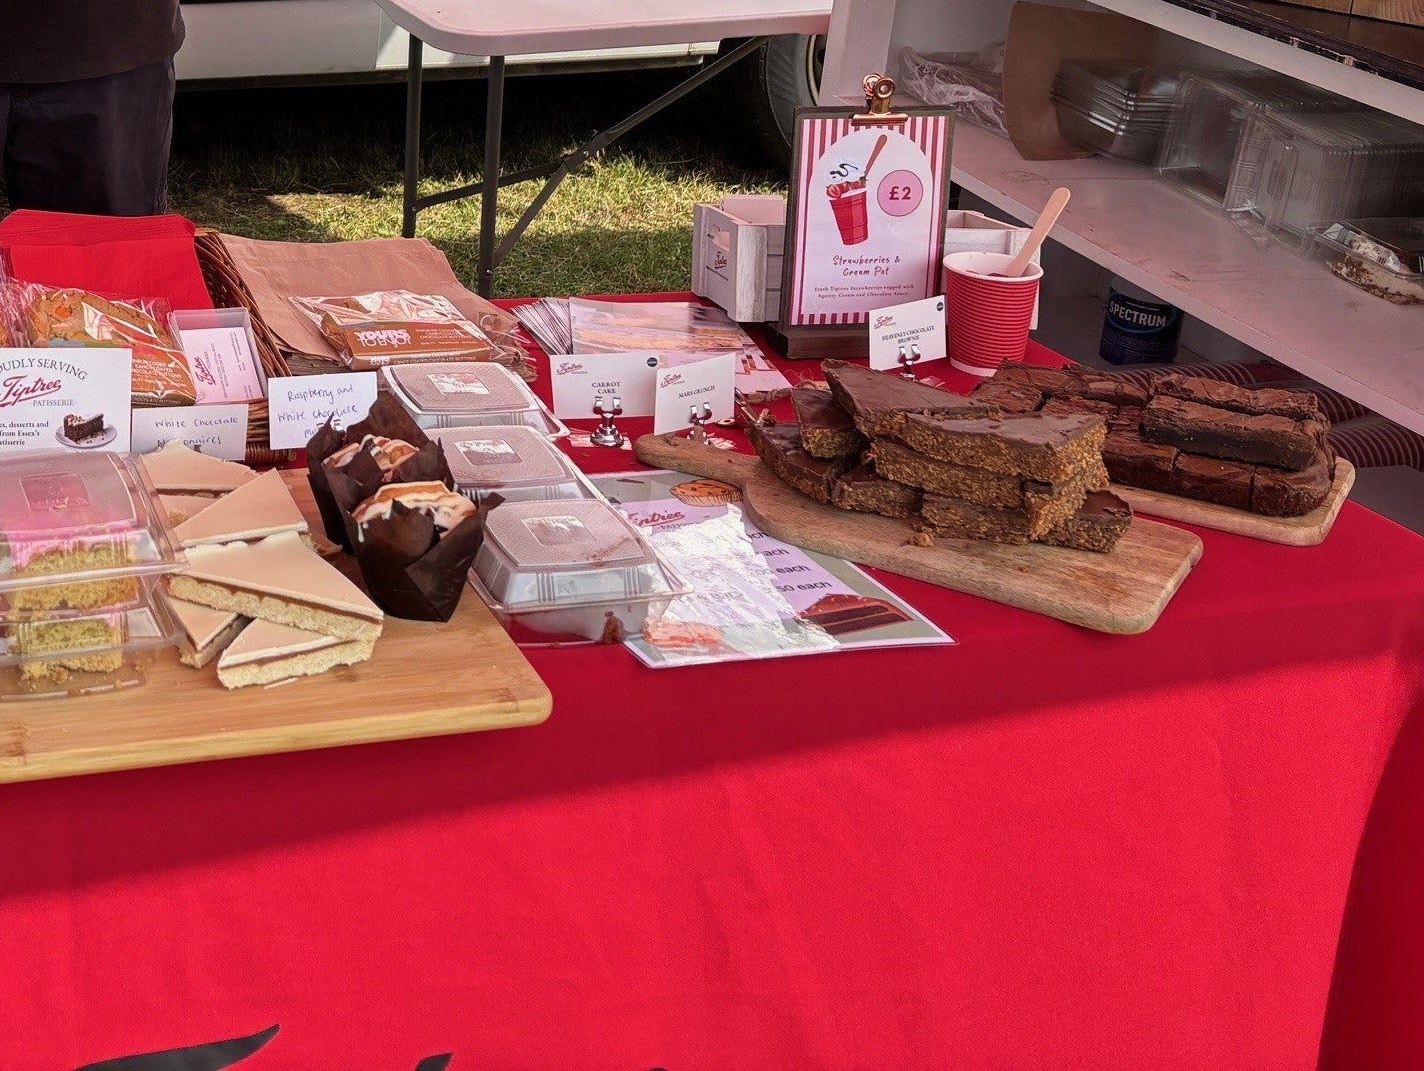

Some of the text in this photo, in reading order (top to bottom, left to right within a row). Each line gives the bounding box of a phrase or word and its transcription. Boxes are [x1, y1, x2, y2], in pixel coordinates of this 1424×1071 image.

[889, 186, 912, 201] £2
[832, 254, 890, 266] Strawberries
[842, 266, 890, 277] Cream Pot
[1109, 300, 1167, 327] SPECTRUM
[37, 358, 88, 381] SERVING
[287, 384, 354, 404] Raspberry and
[678, 385, 716, 398] MARS CRUNCH
[32, 399, 75, 407] PATISSERIE
[36, 420, 49, 428] and
[155, 416, 239, 428] White Chocolate
[0, 429, 16, 437] from
[17, 429, 40, 437] Essex's
[763, 548, 790, 557] ach
[775, 565, 812, 574] each
[796, 581, 833, 590] each
